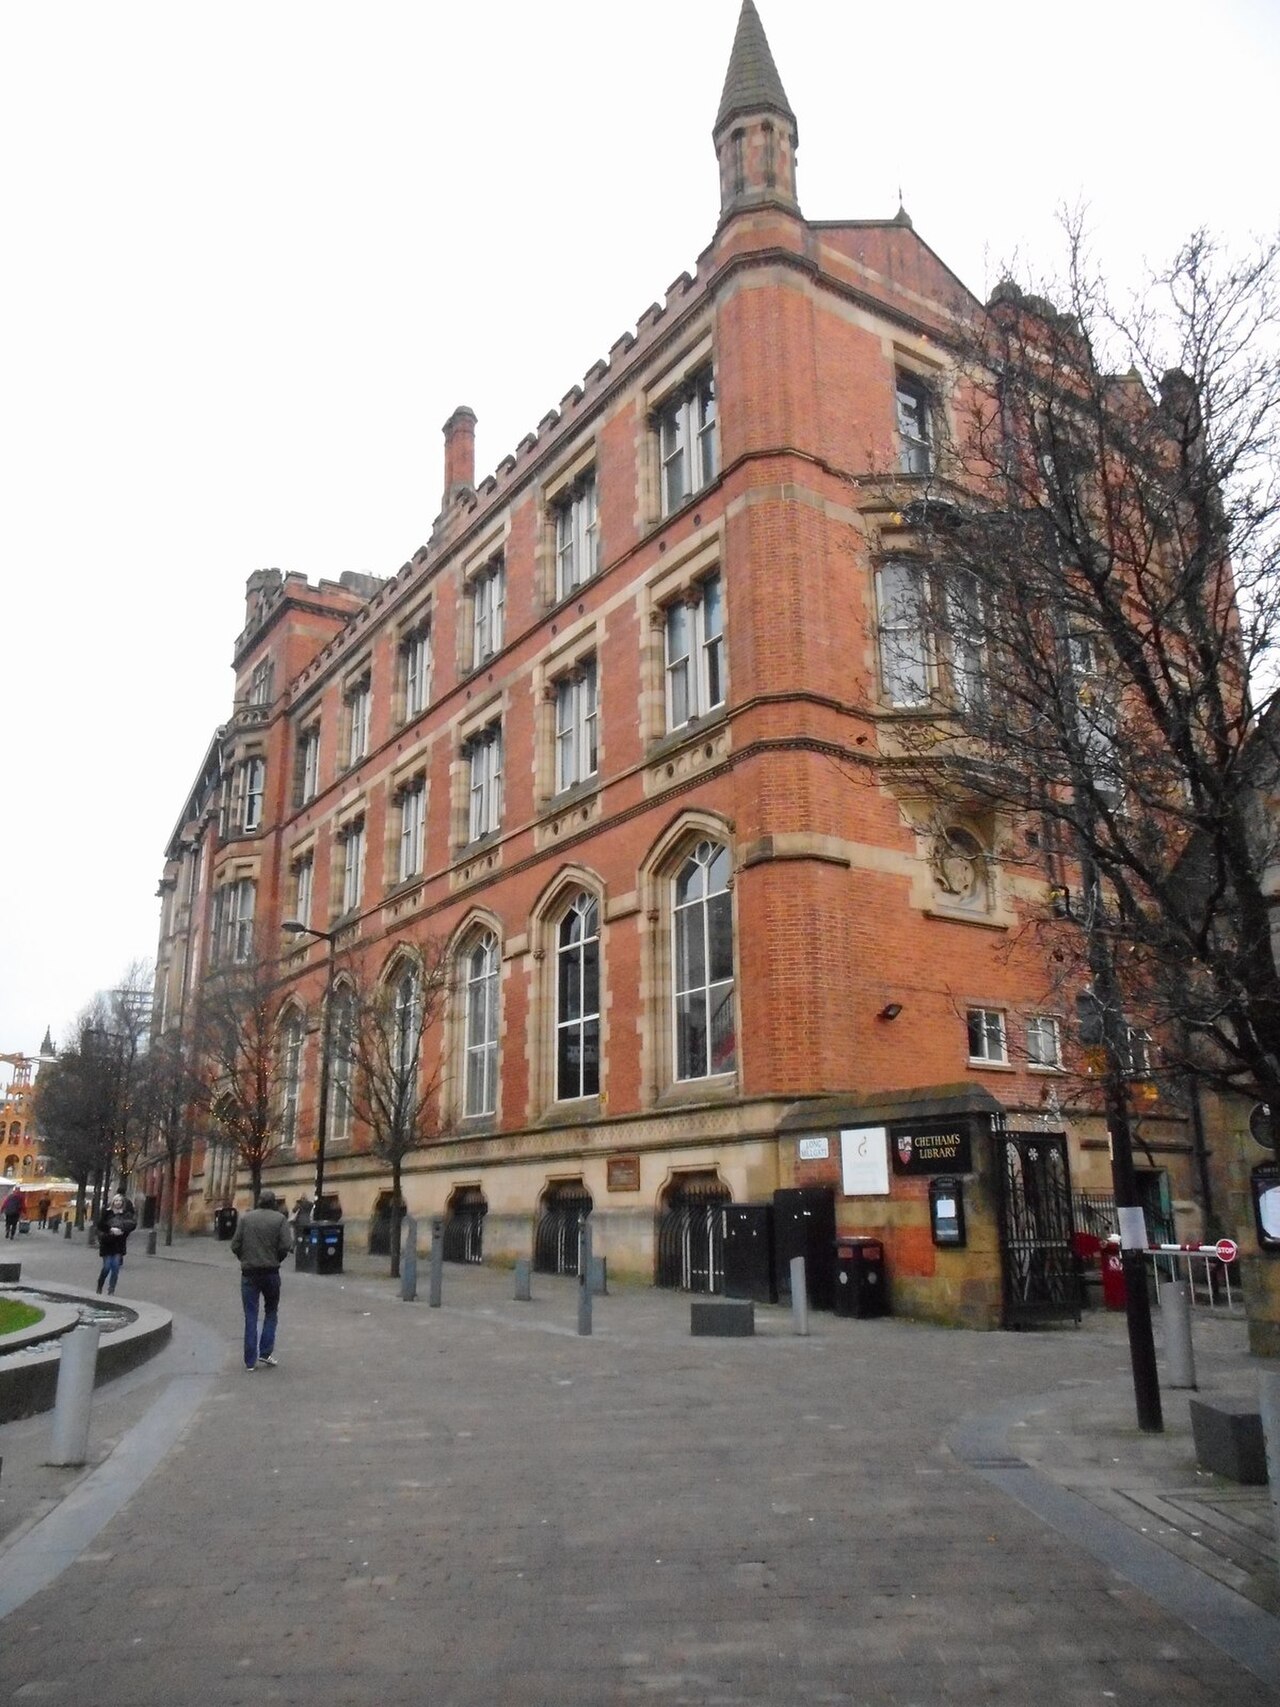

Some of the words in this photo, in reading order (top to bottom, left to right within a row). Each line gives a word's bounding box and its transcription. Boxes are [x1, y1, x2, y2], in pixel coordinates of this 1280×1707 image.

[914, 1133, 961, 1148] CHETHAM'S
[919, 1147, 957, 1160] LIBRARY
[1217, 1246, 1235, 1254] STOP
